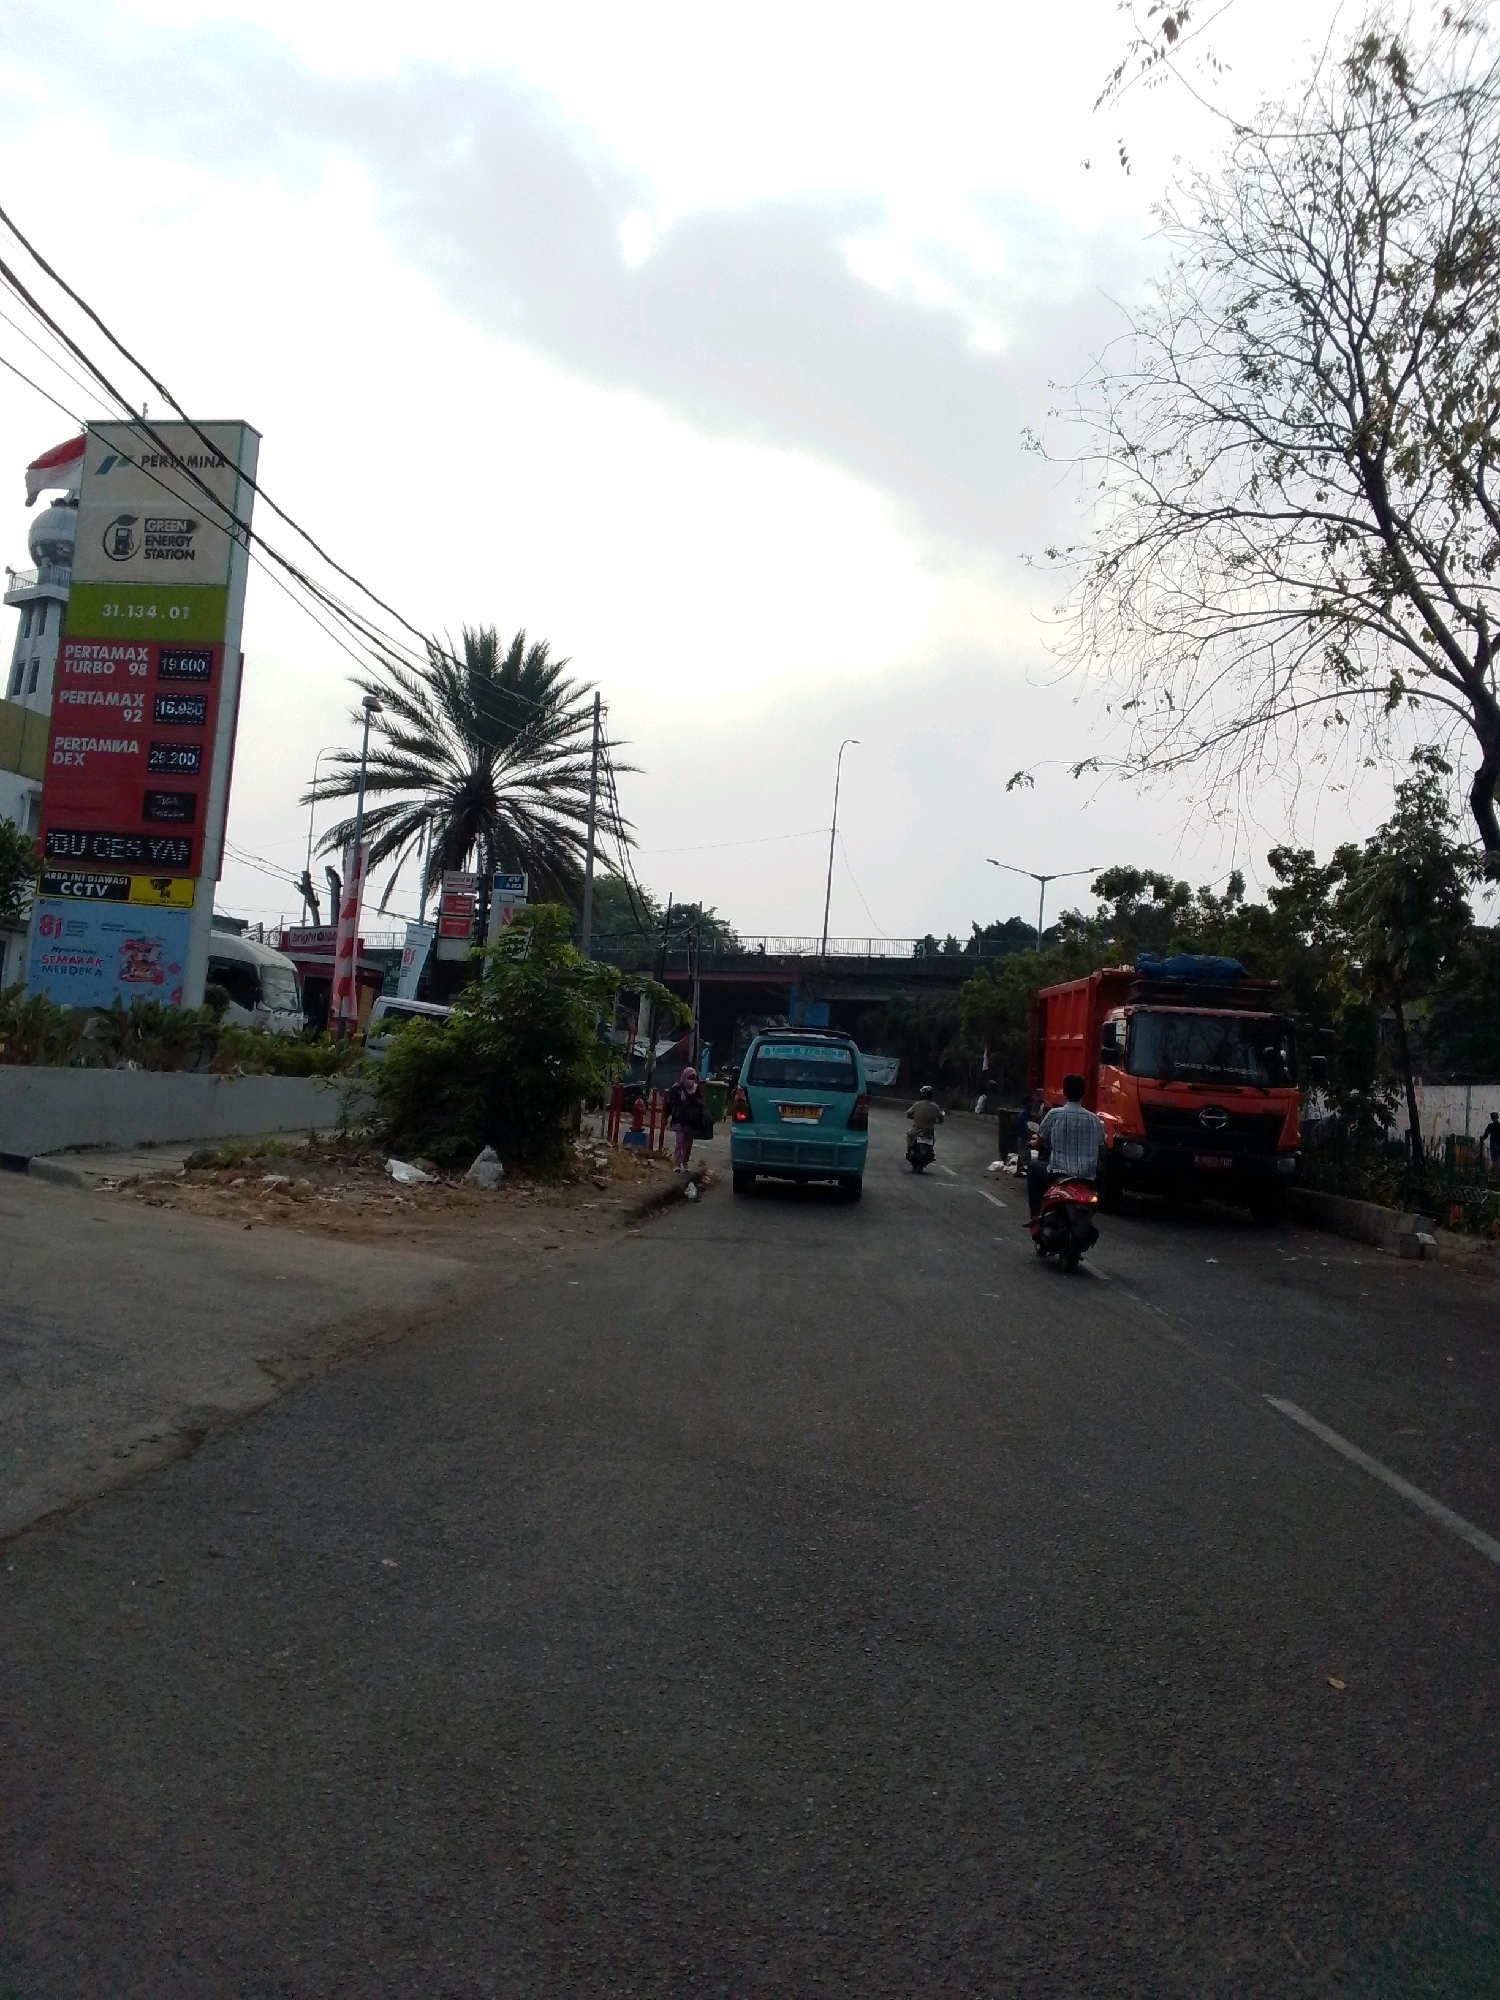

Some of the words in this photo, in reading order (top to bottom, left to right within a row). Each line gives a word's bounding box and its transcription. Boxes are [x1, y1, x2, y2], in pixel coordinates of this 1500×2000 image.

[141, 454, 226, 469] PERTAMINA
[145, 519, 188, 533] GREEN
[144, 535, 194, 548] ENERGY
[143, 547, 195, 561] STATION
[64, 645, 149, 662] PERTAMAX
[64, 660, 116, 675] TURBO
[128, 662, 148, 676] 98
[59, 691, 146, 707] PERTAMAX
[123, 709, 143, 723] 92
[54, 737, 139, 754] PERTAMINA
[52, 751, 86, 766] DEX
[44, 871, 68, 881] AREA
[71, 873, 86, 882] INI
[87, 875, 128, 886] DIAWASI
[60, 881, 109, 897] CCTV
[39, 914, 63, 939] 81
[293, 931, 317, 945] bright
[41, 954, 104, 967] SEMARAK
[42, 965, 103, 977] MERDEKA
